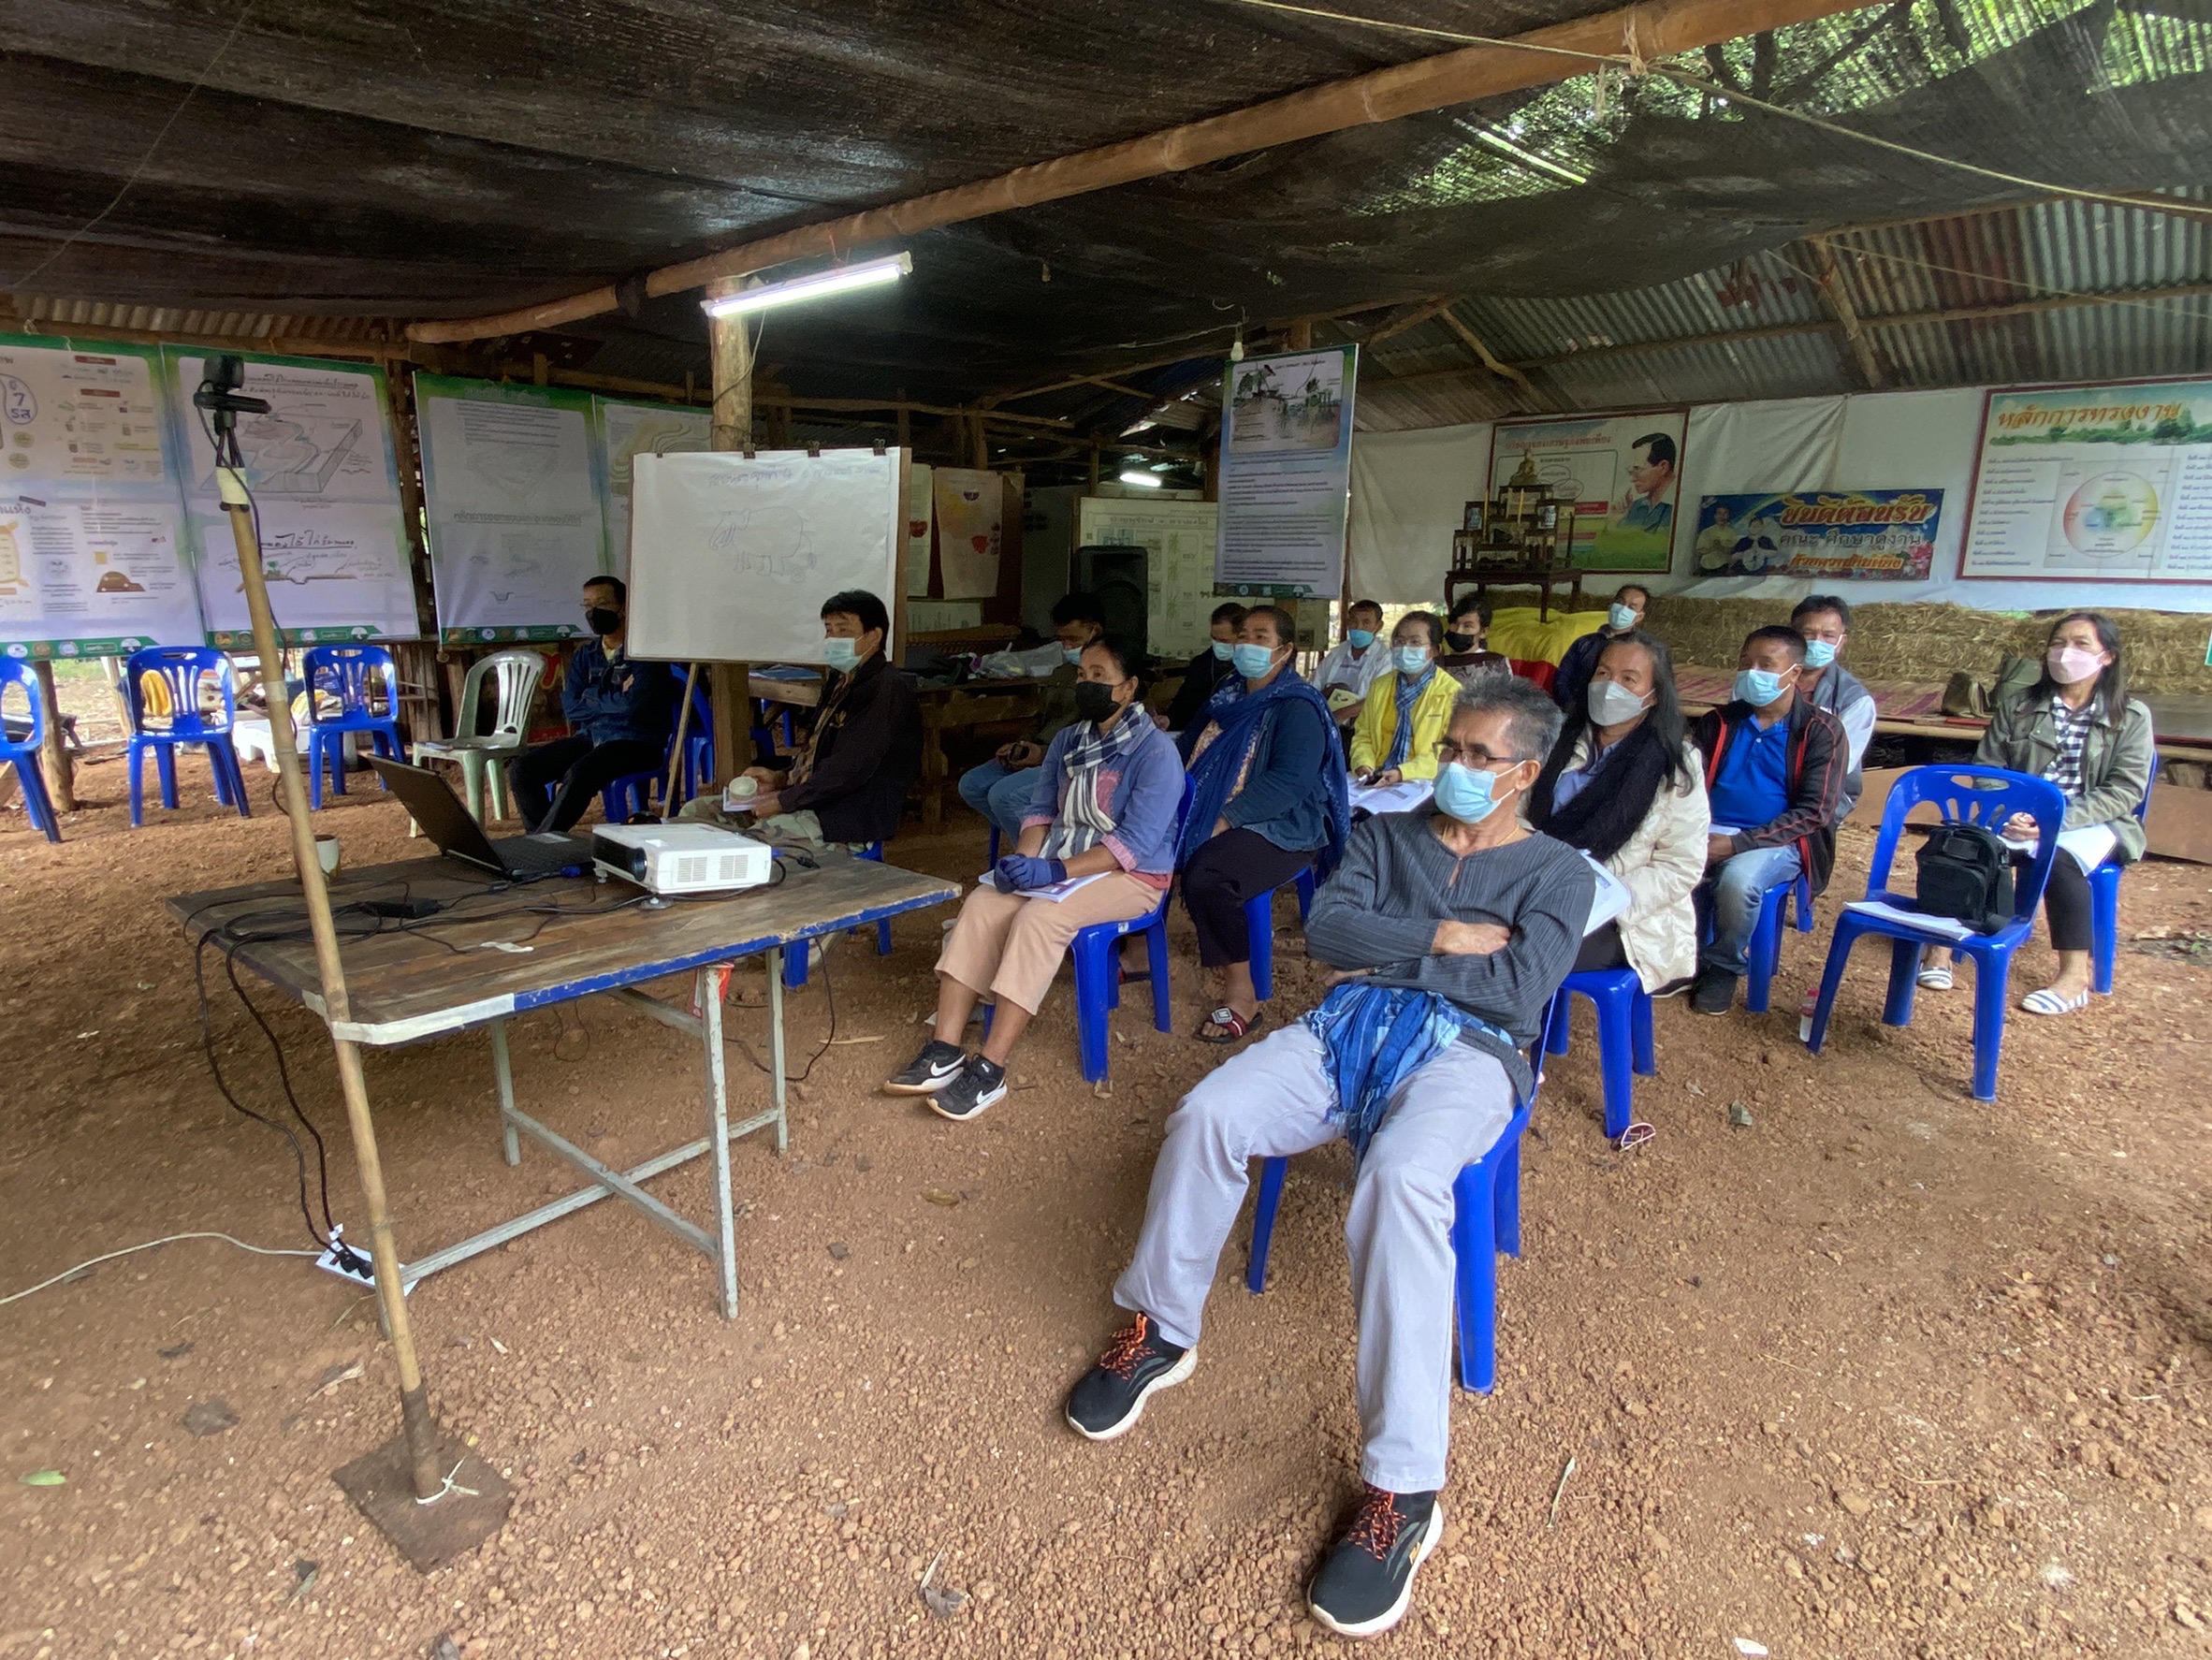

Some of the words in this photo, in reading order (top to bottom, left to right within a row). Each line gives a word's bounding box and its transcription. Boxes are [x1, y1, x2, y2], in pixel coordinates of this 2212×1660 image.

[1998, 402, 2183, 429] หลักการทรงงาน
[1780, 494, 1931, 525] ยินดีต้อนรับ
[1780, 533, 1819, 546] คณะ
[1826, 529, 1921, 550] ศึกษาดูงาน
